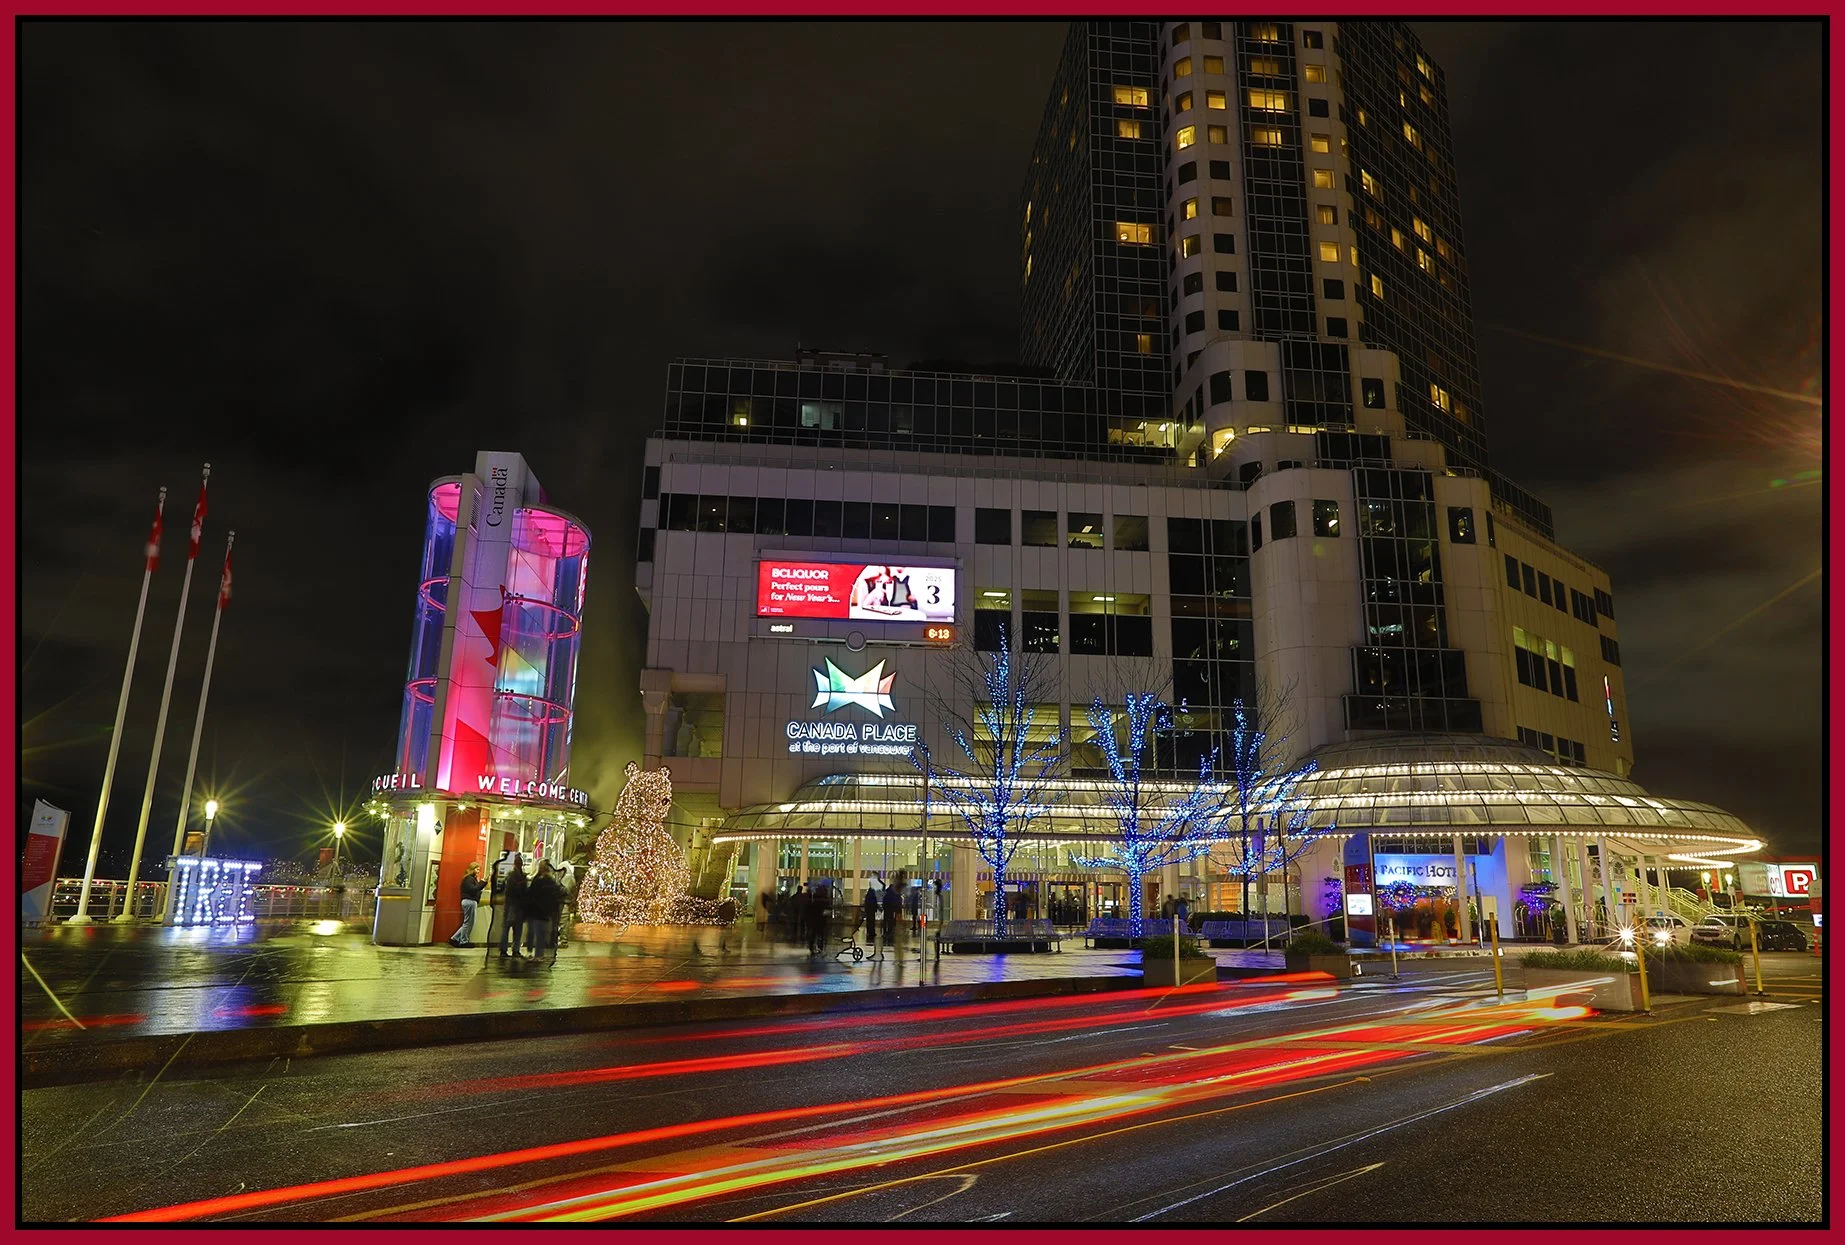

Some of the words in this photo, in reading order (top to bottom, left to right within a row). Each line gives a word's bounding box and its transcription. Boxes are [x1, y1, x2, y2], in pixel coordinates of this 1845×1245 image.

[485, 466, 508, 527] Canada
[771, 568, 829, 580] BCLIQUOR
[771, 581, 803, 591] Perfect
[804, 584, 829, 592] pours
[927, 585, 940, 604] 3
[770, 592, 784, 601] for
[785, 593, 806, 601] New
[928, 628, 950, 639] 6:13
[787, 721, 857, 740] CANADA
[862, 724, 917, 741] PLACE
[789, 741, 801, 753] at
[802, 740, 820, 753] the
[821, 741, 845, 756] port
[846, 741, 858, 753] of
[859, 743, 914, 756] vancouver
[478, 775, 566, 800] WELCOME
[1381, 865, 1424, 876] PACIFIC
[173, 858, 263, 923] TREE
